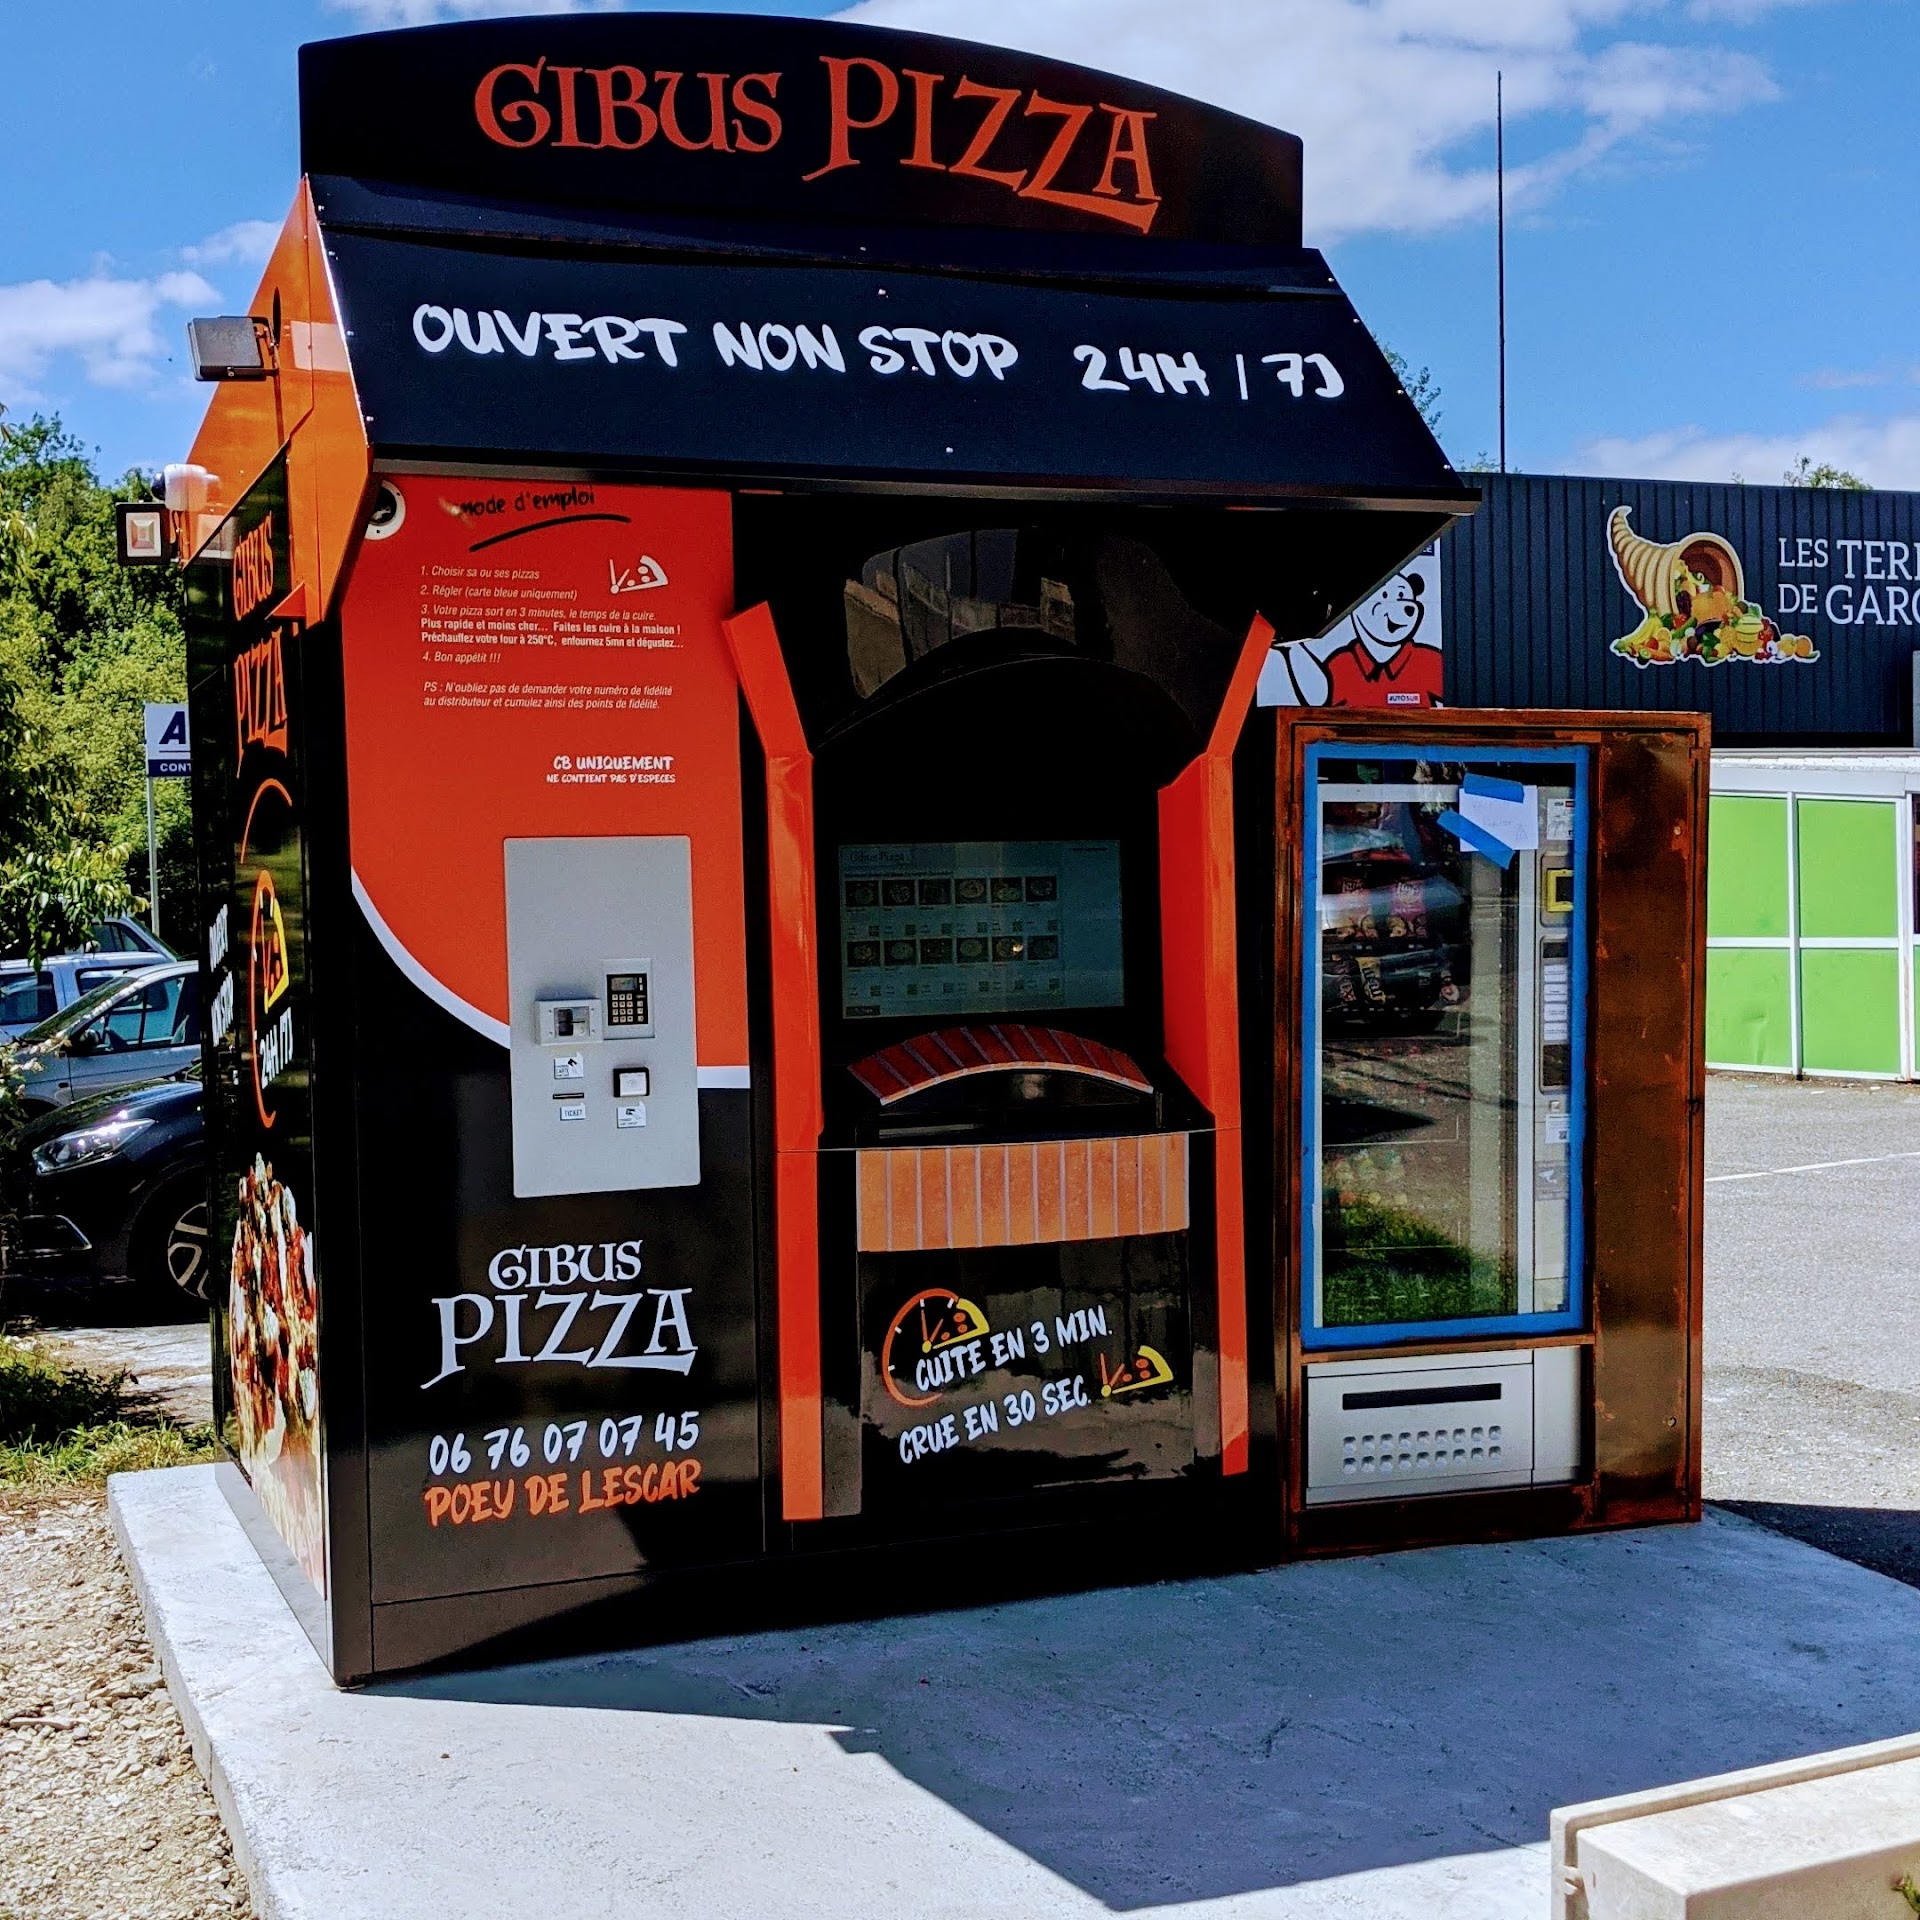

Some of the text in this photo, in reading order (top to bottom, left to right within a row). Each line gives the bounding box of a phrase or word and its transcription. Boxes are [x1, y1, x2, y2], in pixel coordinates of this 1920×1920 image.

[474, 55, 1162, 233] GIBUS PIZZA
[412, 303, 688, 367] OUVERT
[712, 321, 846, 374] NON
[858, 326, 1018, 380] STOP
[1073, 344, 1210, 396] 24H
[1262, 352, 1344, 398] 7J
[459, 485, 595, 516] mode d'emploi
[233, 510, 273, 621] GIBUS
[420, 565, 540, 581] 1. Choisir sa ou ses pizzas
[1778, 537, 1920, 580] LES TER
[420, 584, 578, 601] 2. Régler (carte bleue uniquement)
[1777, 583, 1920, 625] DE GAR
[420, 618, 442, 629] Plus
[444, 619, 474, 632] rapide
[476, 619, 486, 630] et
[488, 620, 516, 631] moins
[553, 622, 581, 632] Faites
[583, 622, 597, 633] les
[599, 623, 621, 633] cuire
[623, 623, 630, 633] à
[631, 624, 640, 634] la
[642, 624, 675, 635] maison
[432, 605, 458, 615] Votre
[459, 606, 483, 617] pizza
[485, 606, 504, 617] sort
[506, 608, 518, 617] en
[519, 607, 526, 617] 3
[569, 609, 577, 618] le
[579, 609, 607, 621] temps
[609, 609, 621, 620] de
[622, 610, 631, 620] la
[632, 611, 657, 621] cuire.
[421, 631, 473, 644] Préchauffez
[475, 633, 498, 644] votre
[500, 633, 518, 644] four
[519, 634, 526, 644] à
[605, 636, 625, 647] 5mn
[626, 637, 635, 647] et
[422, 651, 501, 665] 4. Bon appétit !!!
[234, 626, 288, 779] PIZZA
[423, 681, 438, 692] PS
[445, 681, 488, 694] N'oubliez
[489, 684, 506, 695] pas
[508, 683, 520, 694] de
[521, 683, 567, 695] demander
[569, 685, 593, 696] votre
[594, 685, 629, 696] numéro
[630, 685, 641, 696] de
[643, 686, 673, 697] fidélité
[423, 695, 661, 711] au distributeur et cumulez ainsi des points de fidélité.
[546, 772, 676, 784] NE CONTIENT PAS D'ESPECES
[553, 755, 675, 771] CB UNIQUEMENT
[564, 1109, 583, 1117] TICKET
[488, 1239, 644, 1290] GIBUS
[420, 1288, 699, 1390] PIZZA
[915, 1304, 1113, 1392] CUITE EN 3 MIN.
[899, 1374, 1092, 1465] CRUE EN 30 SEC.
[429, 1410, 700, 1476] 06 76 07 07 45
[423, 1457, 702, 1528] POEY DE LESCAR
